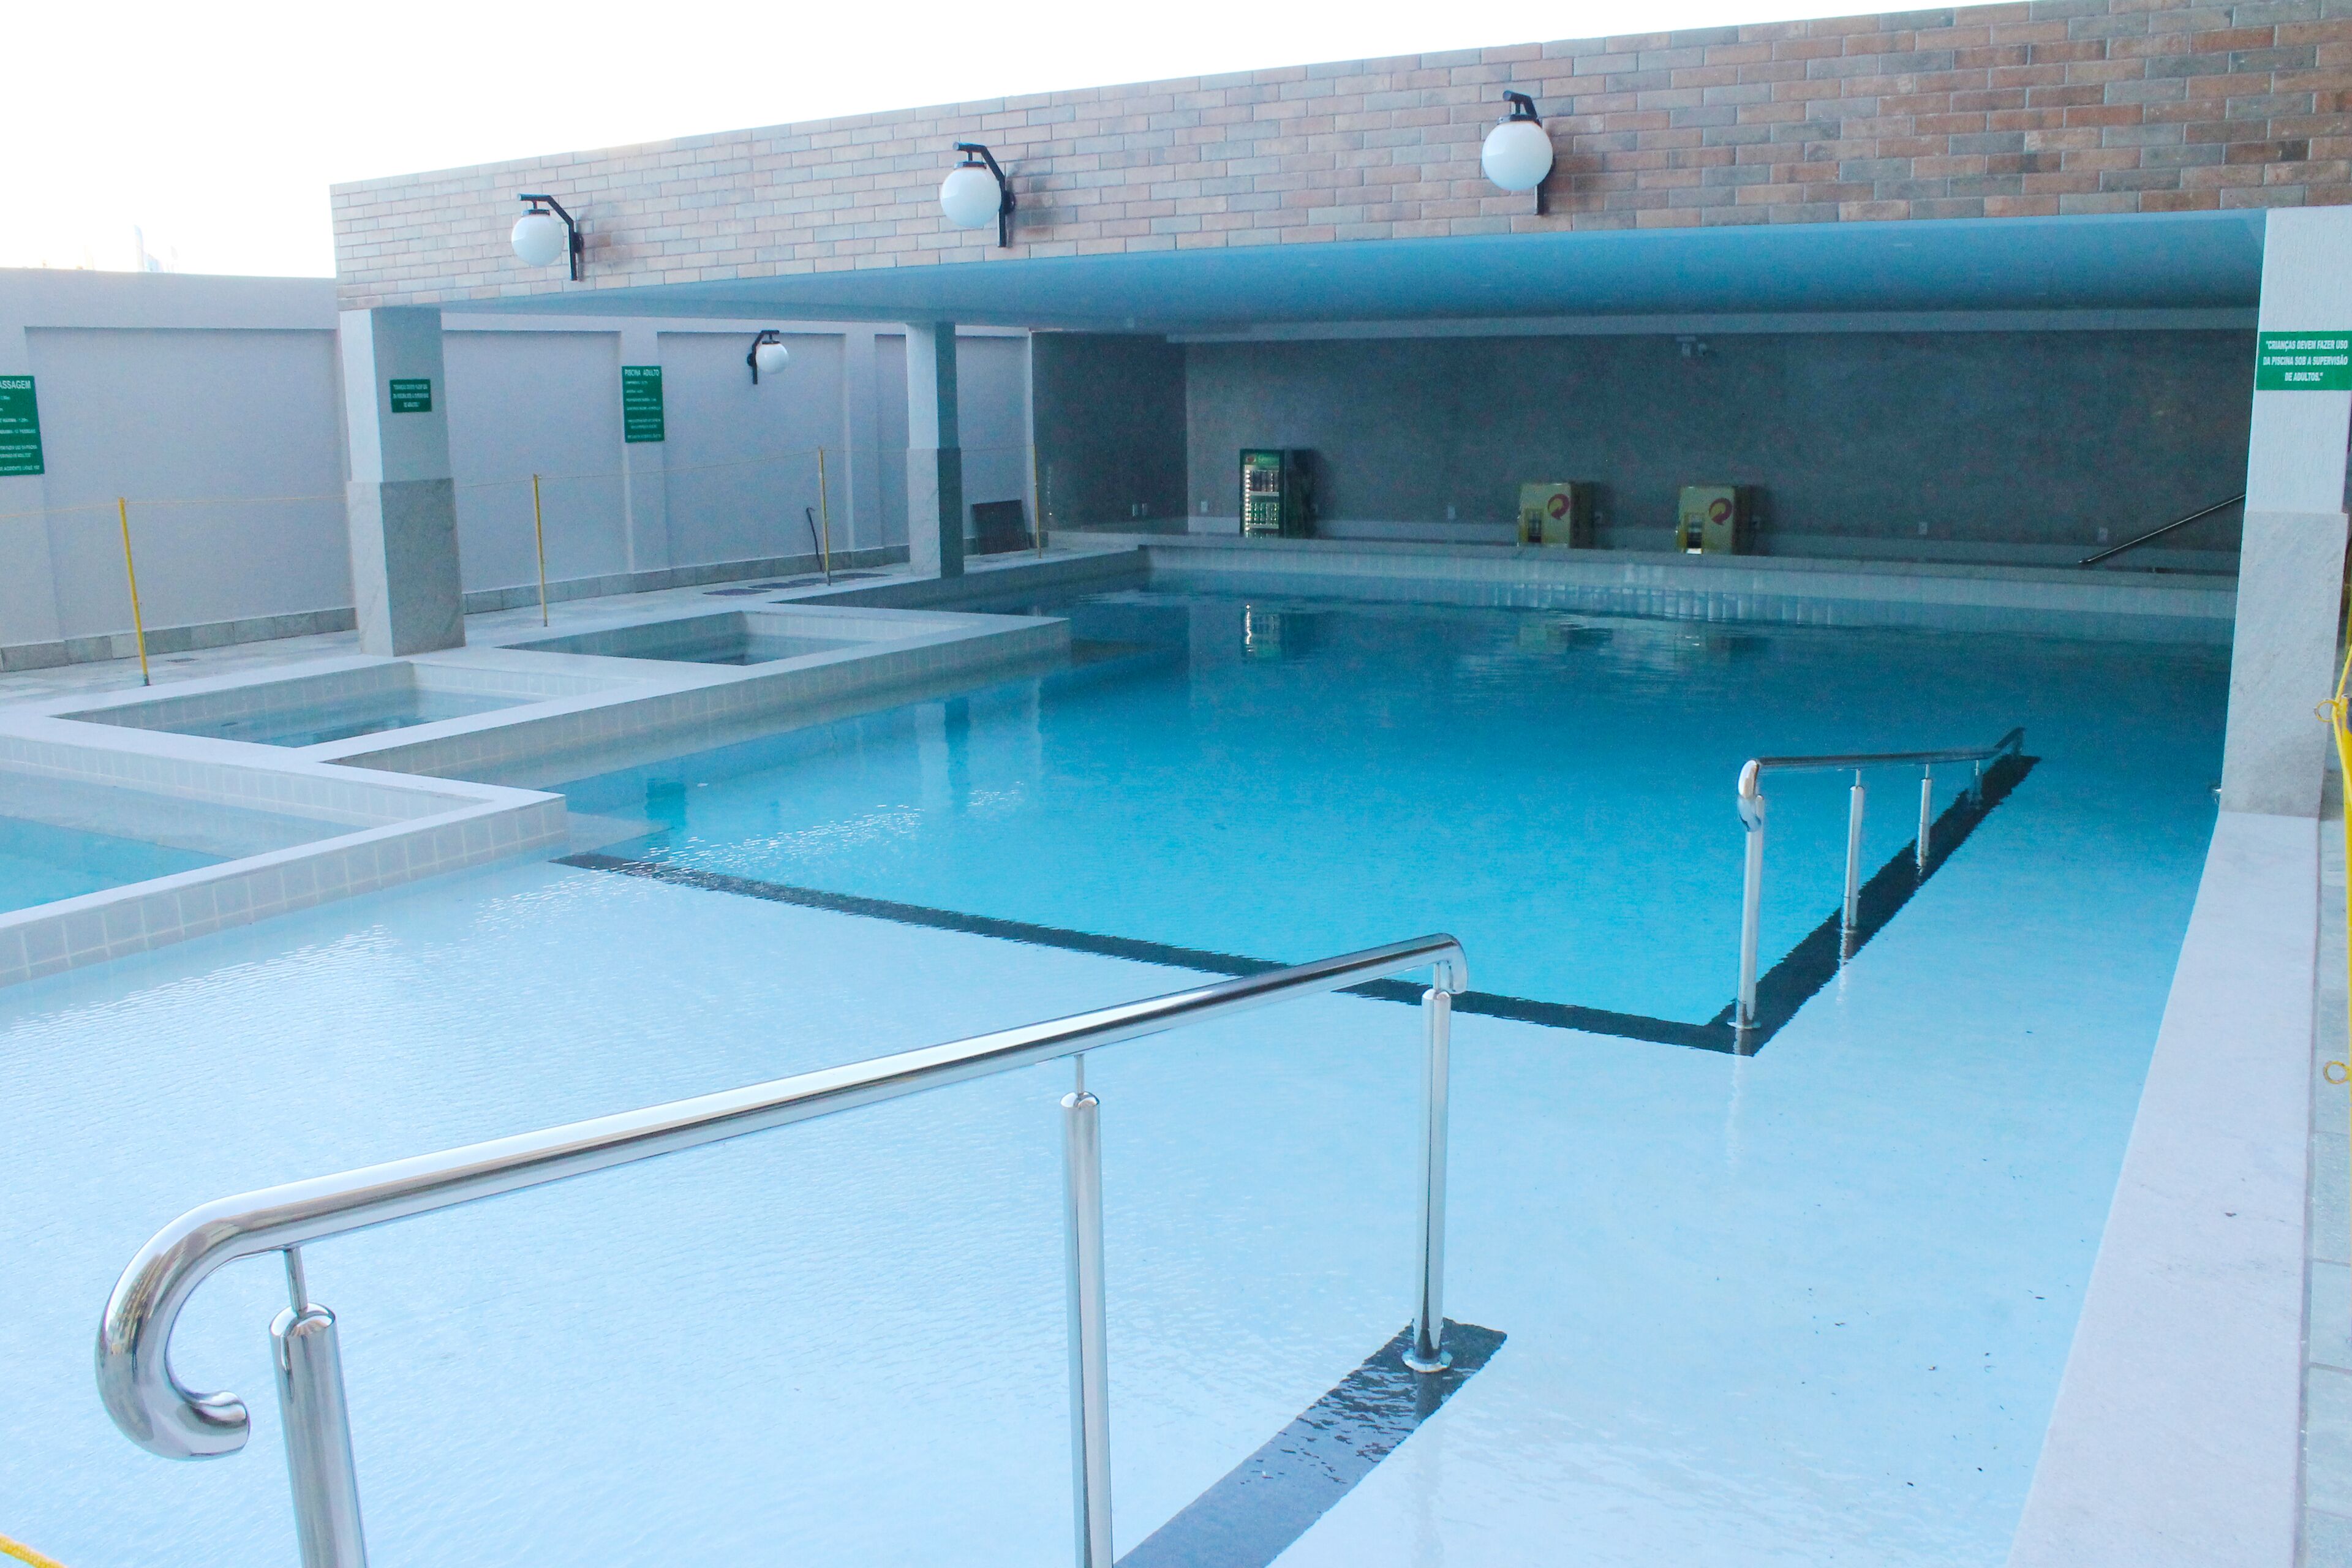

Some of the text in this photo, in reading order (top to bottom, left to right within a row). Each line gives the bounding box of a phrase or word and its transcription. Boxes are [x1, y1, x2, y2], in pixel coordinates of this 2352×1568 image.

[2296, 340, 2316, 350] DEVEM
[2316, 340, 2335, 350] FAZER
[2335, 340, 2348, 350] USO
[2263, 354, 2348, 366] DA PISCINA SOB A SUPERVISÃO
[2285, 372, 2293, 382] DE
